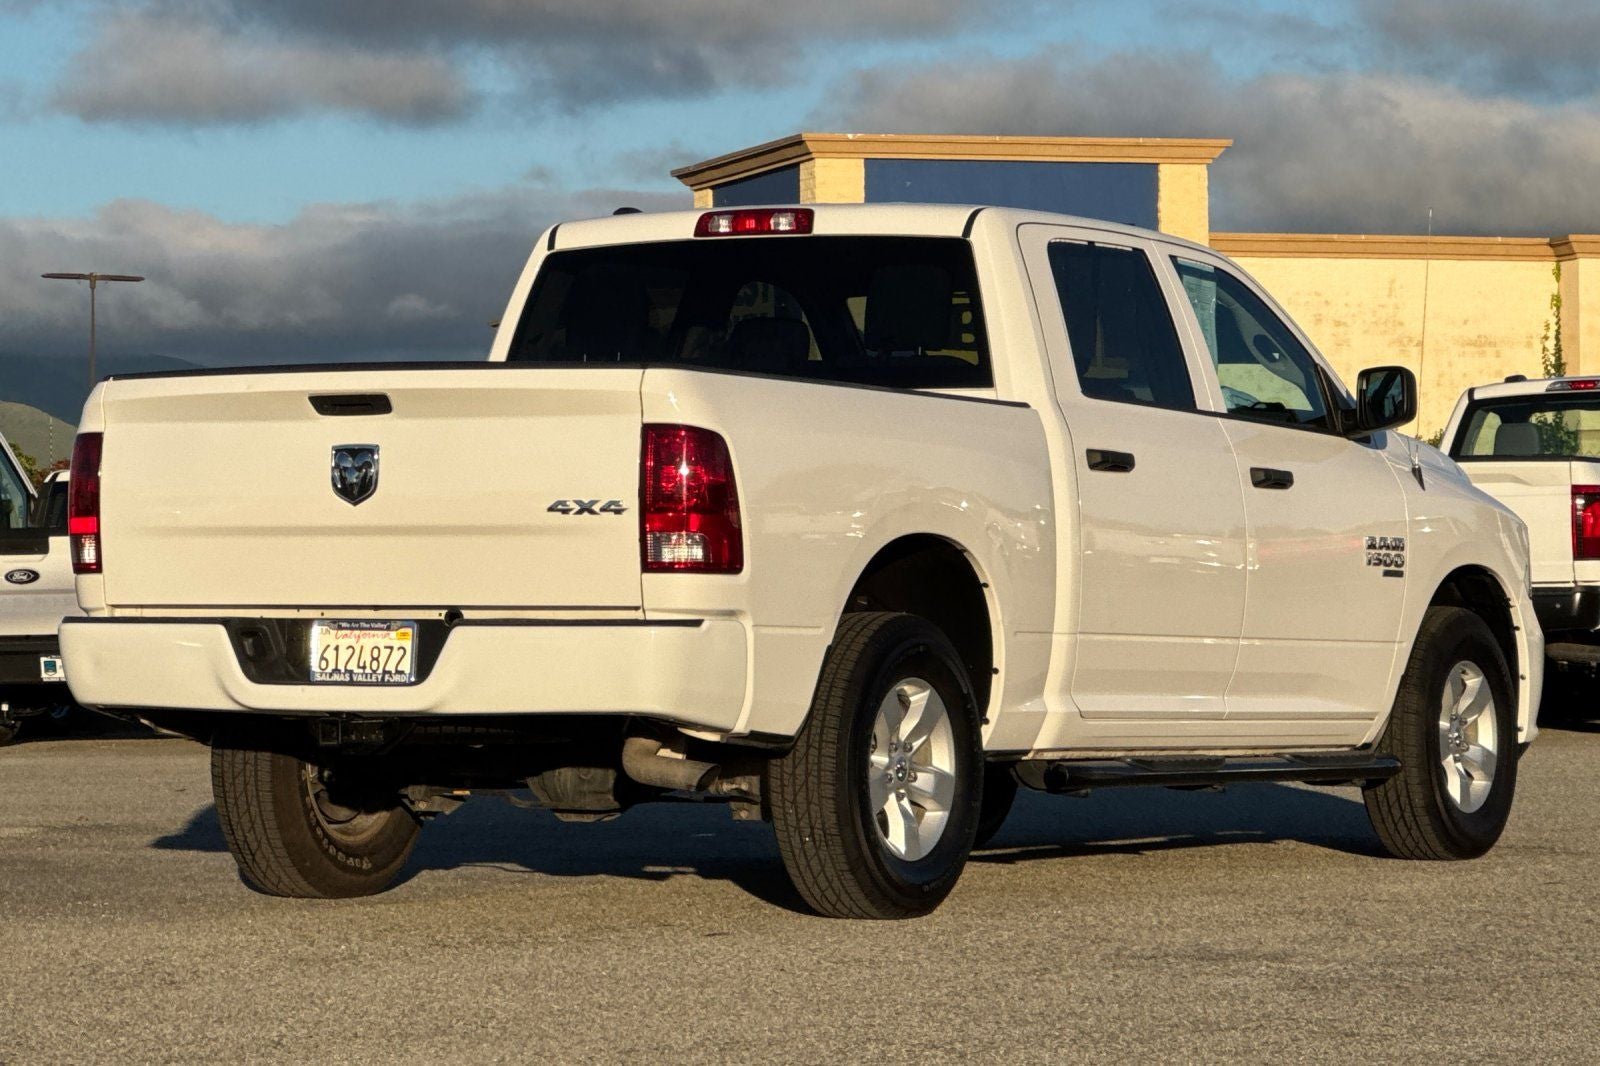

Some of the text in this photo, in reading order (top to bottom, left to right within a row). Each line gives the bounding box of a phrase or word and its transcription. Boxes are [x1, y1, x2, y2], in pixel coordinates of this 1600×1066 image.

[1366, 535, 1405, 551] RAM
[1366, 552, 1405, 568] 1500
[315, 673, 407, 682] SALINAS VALLEY FORD
